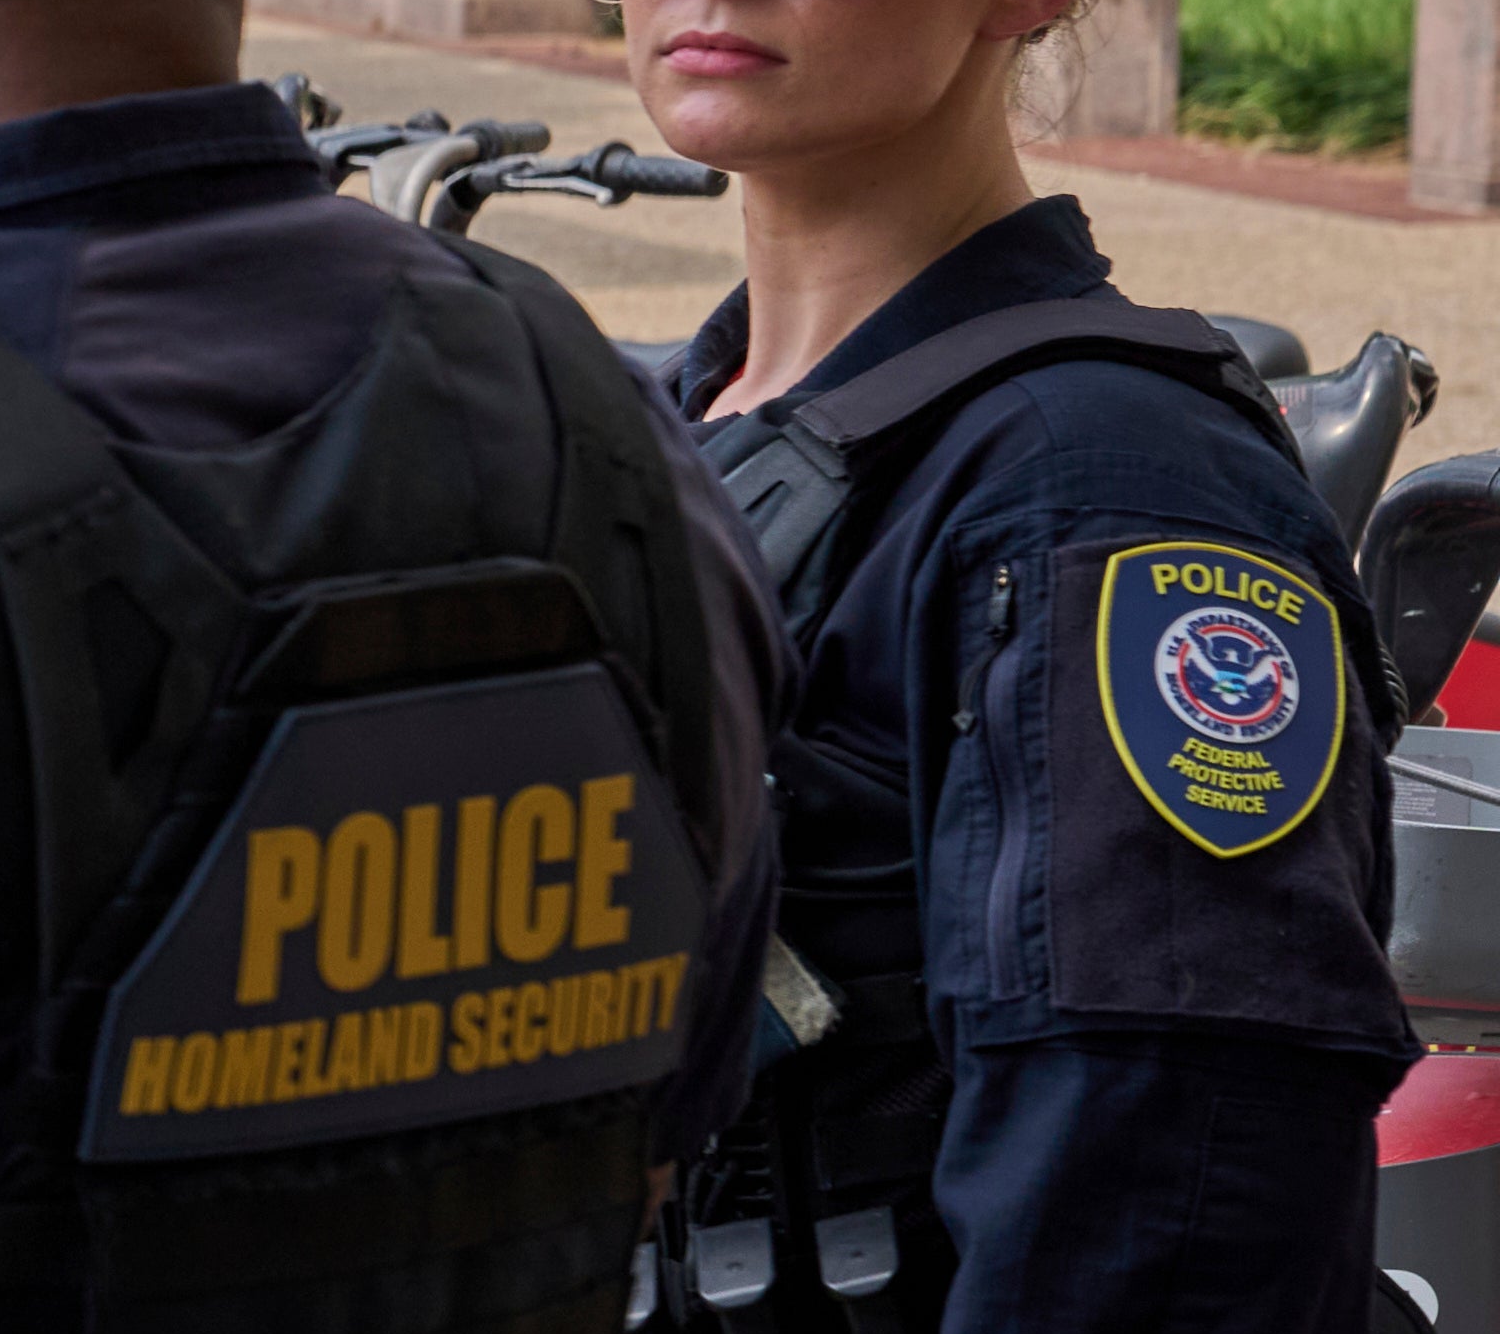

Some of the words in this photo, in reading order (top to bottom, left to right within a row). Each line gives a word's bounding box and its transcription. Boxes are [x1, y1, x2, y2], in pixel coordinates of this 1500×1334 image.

[1150, 563, 1306, 625] POLICE
[1167, 753, 1285, 791] PROTECTIVE
[1182, 736, 1271, 769] FEDERAL
[1185, 784, 1267, 814] SERVICE
[235, 772, 637, 1006] POLICE
[119, 999, 444, 1117] HOMELAND
[447, 951, 690, 1075] SECURITY
